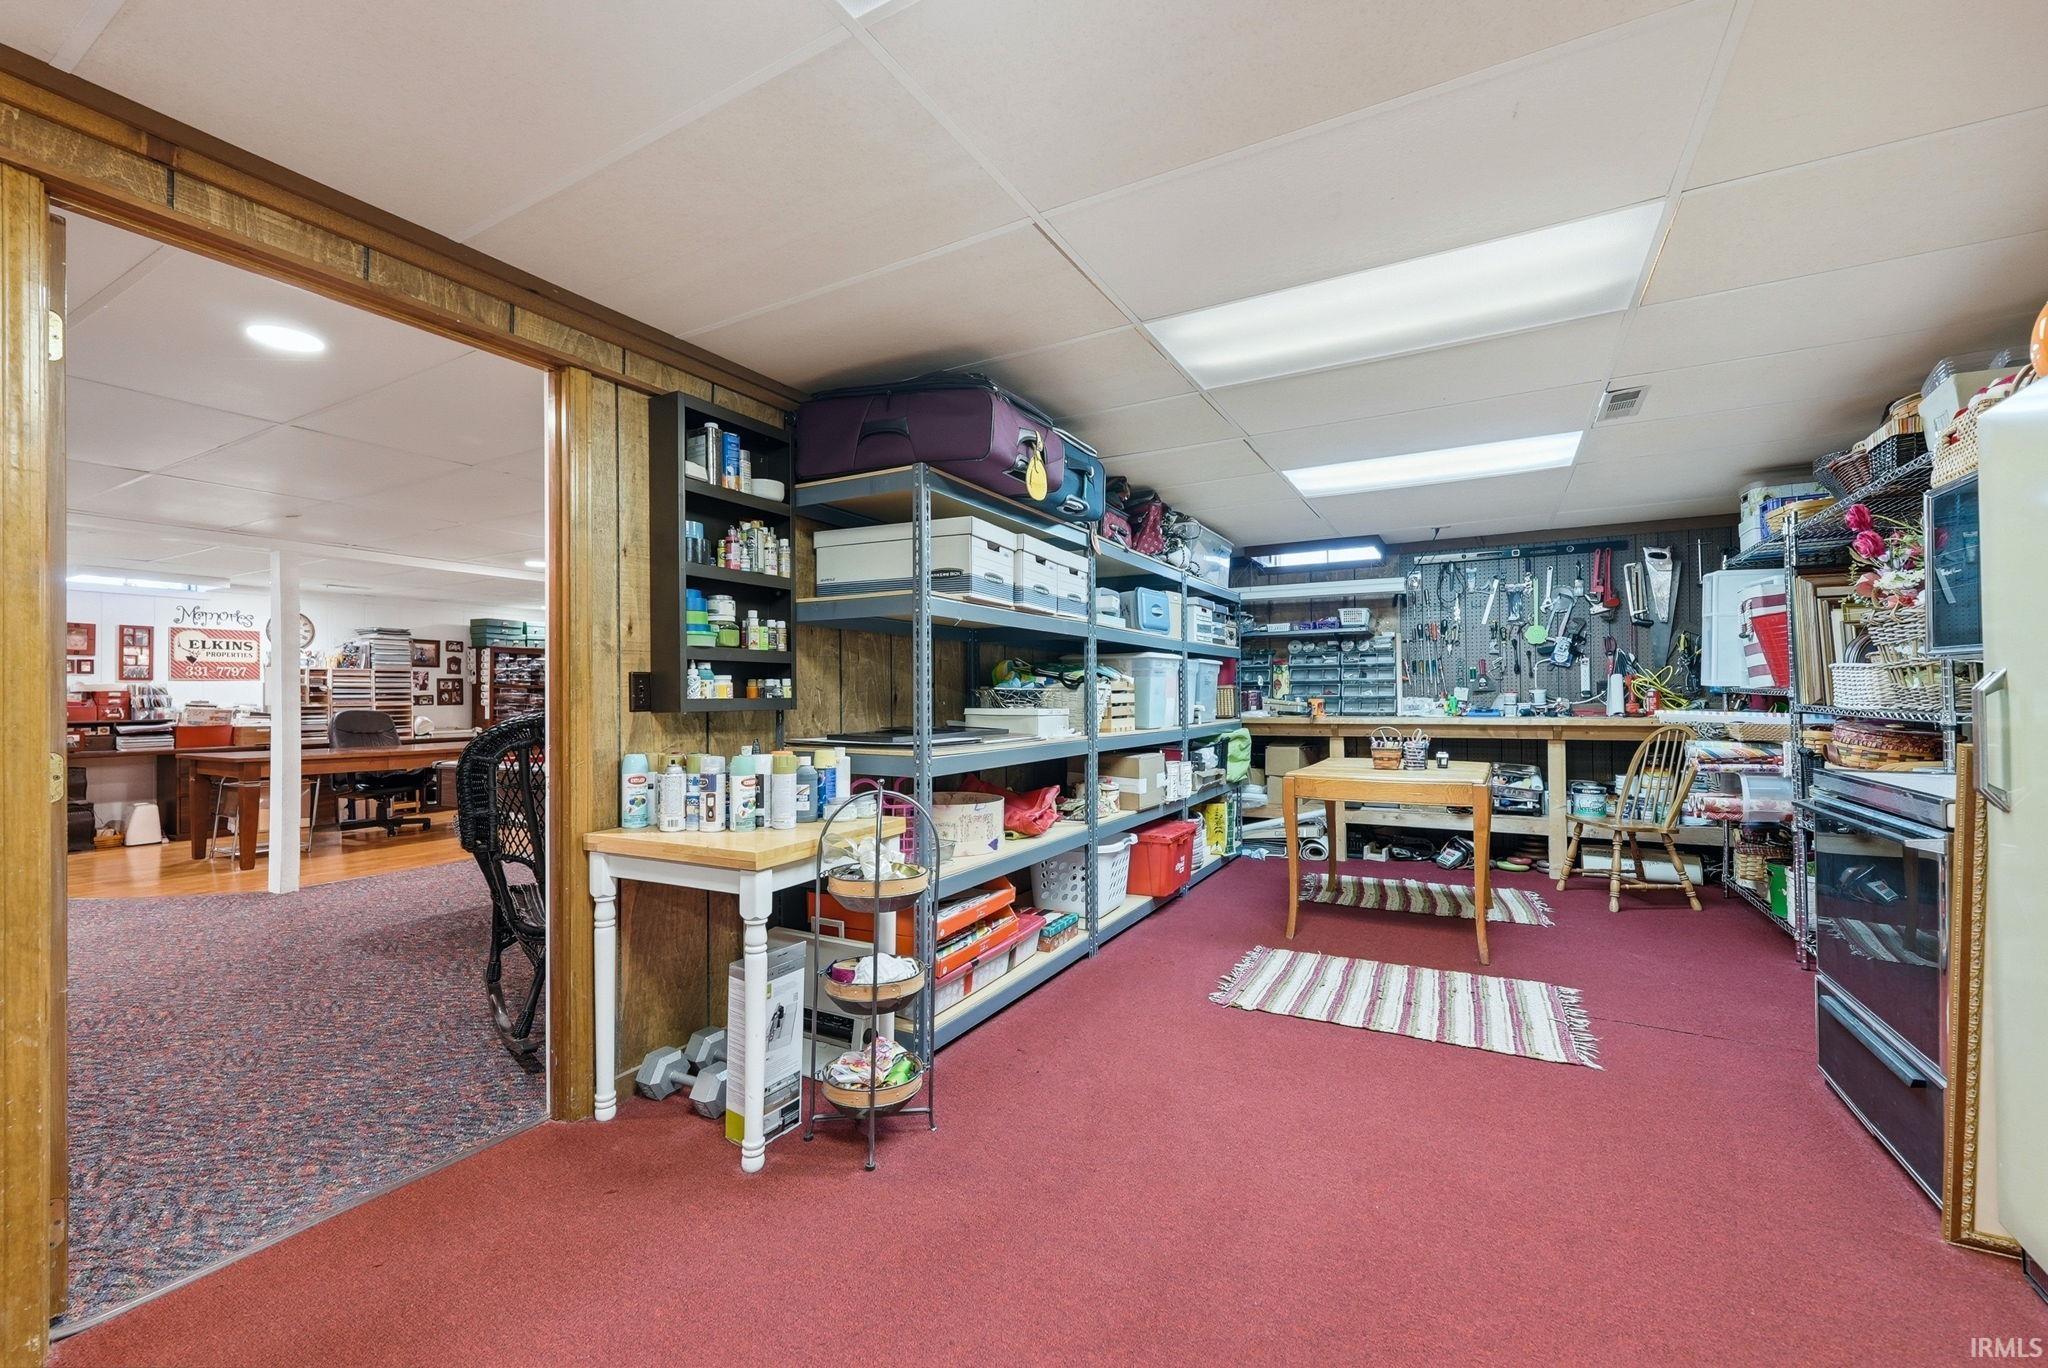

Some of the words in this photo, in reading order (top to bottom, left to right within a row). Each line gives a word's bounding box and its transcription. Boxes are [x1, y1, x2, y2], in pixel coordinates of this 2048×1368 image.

[173, 605, 255, 628] Memories
[188, 639, 254, 651] ELKINS
[205, 651, 254, 659] PROPERTIES
[185, 666, 248, 677] 331-7797
